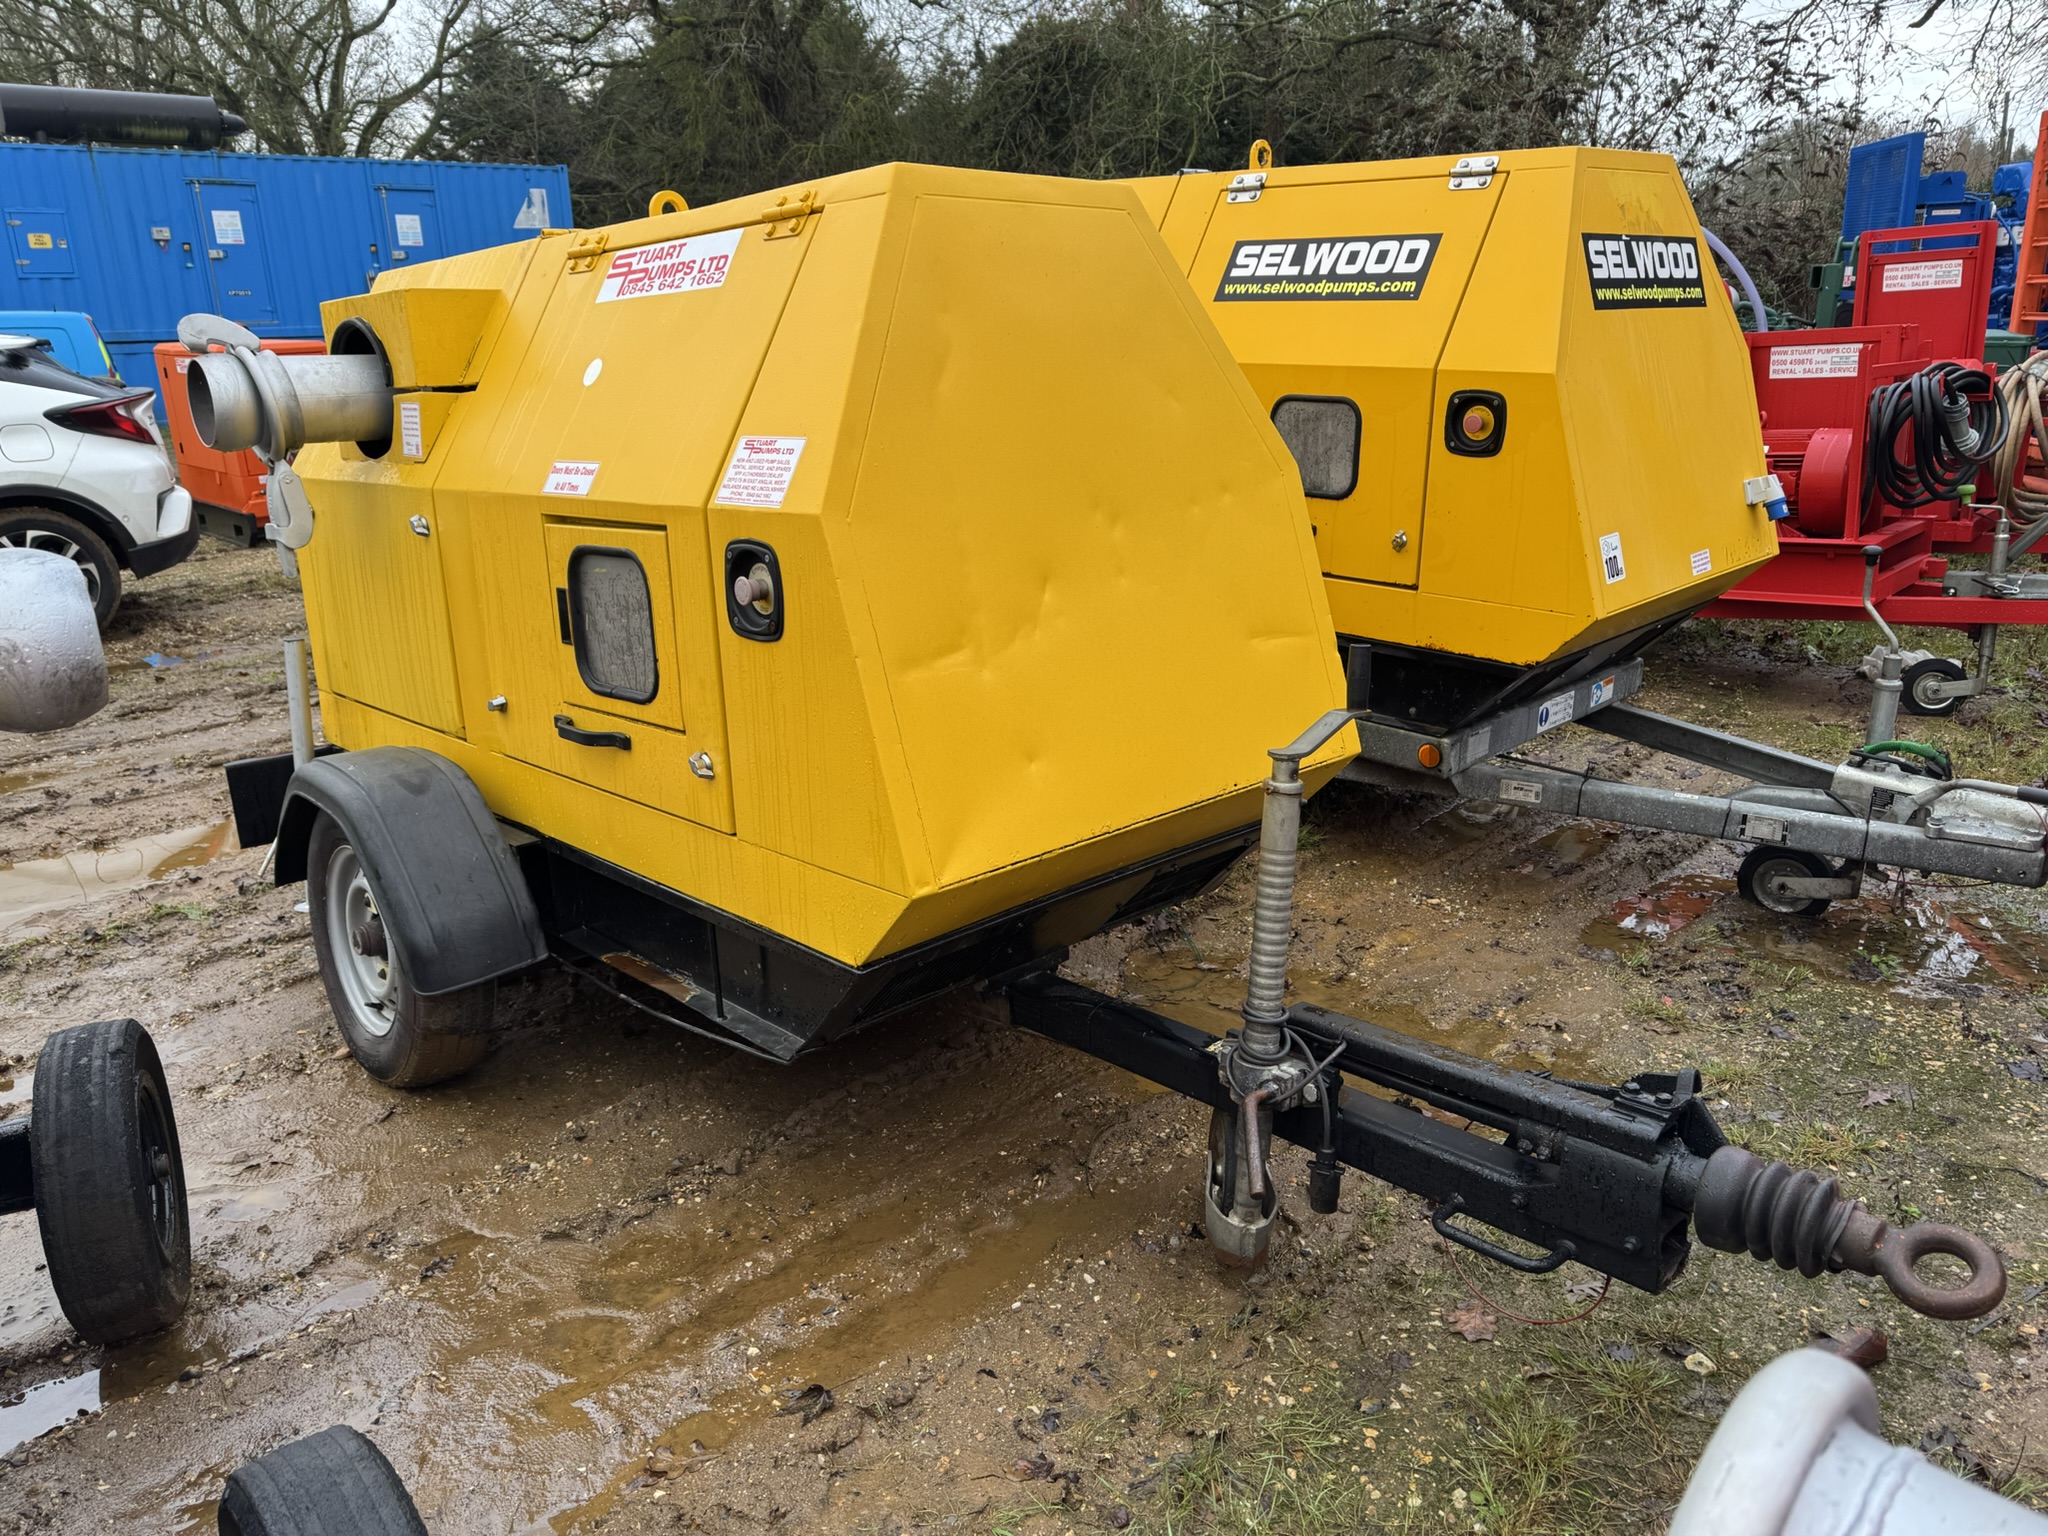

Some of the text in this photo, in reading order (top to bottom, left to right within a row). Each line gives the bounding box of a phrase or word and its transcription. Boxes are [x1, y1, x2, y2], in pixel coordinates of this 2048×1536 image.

[608, 242, 687, 276] STUART
[1229, 239, 1431, 277] SELWOOD
[1588, 240, 1698, 279] SELWOOD
[617, 254, 730, 297] PUMPS LTD
[621, 270, 726, 297] 0845 642 1662
[1885, 278, 1959, 289] RENTAL SALES SERVICE
[1224, 280, 1416, 296] www.selwoodpumps.com
[1595, 284, 1703, 302] www.selwoodpumps.com
[1771, 358, 1788, 367] 0500
[1802, 367, 1824, 375] SALES
[1829, 366, 1857, 374] SERVICE
[743, 440, 778, 450] STUART
[781, 447, 795, 456] LTD
[1605, 555, 1620, 580] 100
